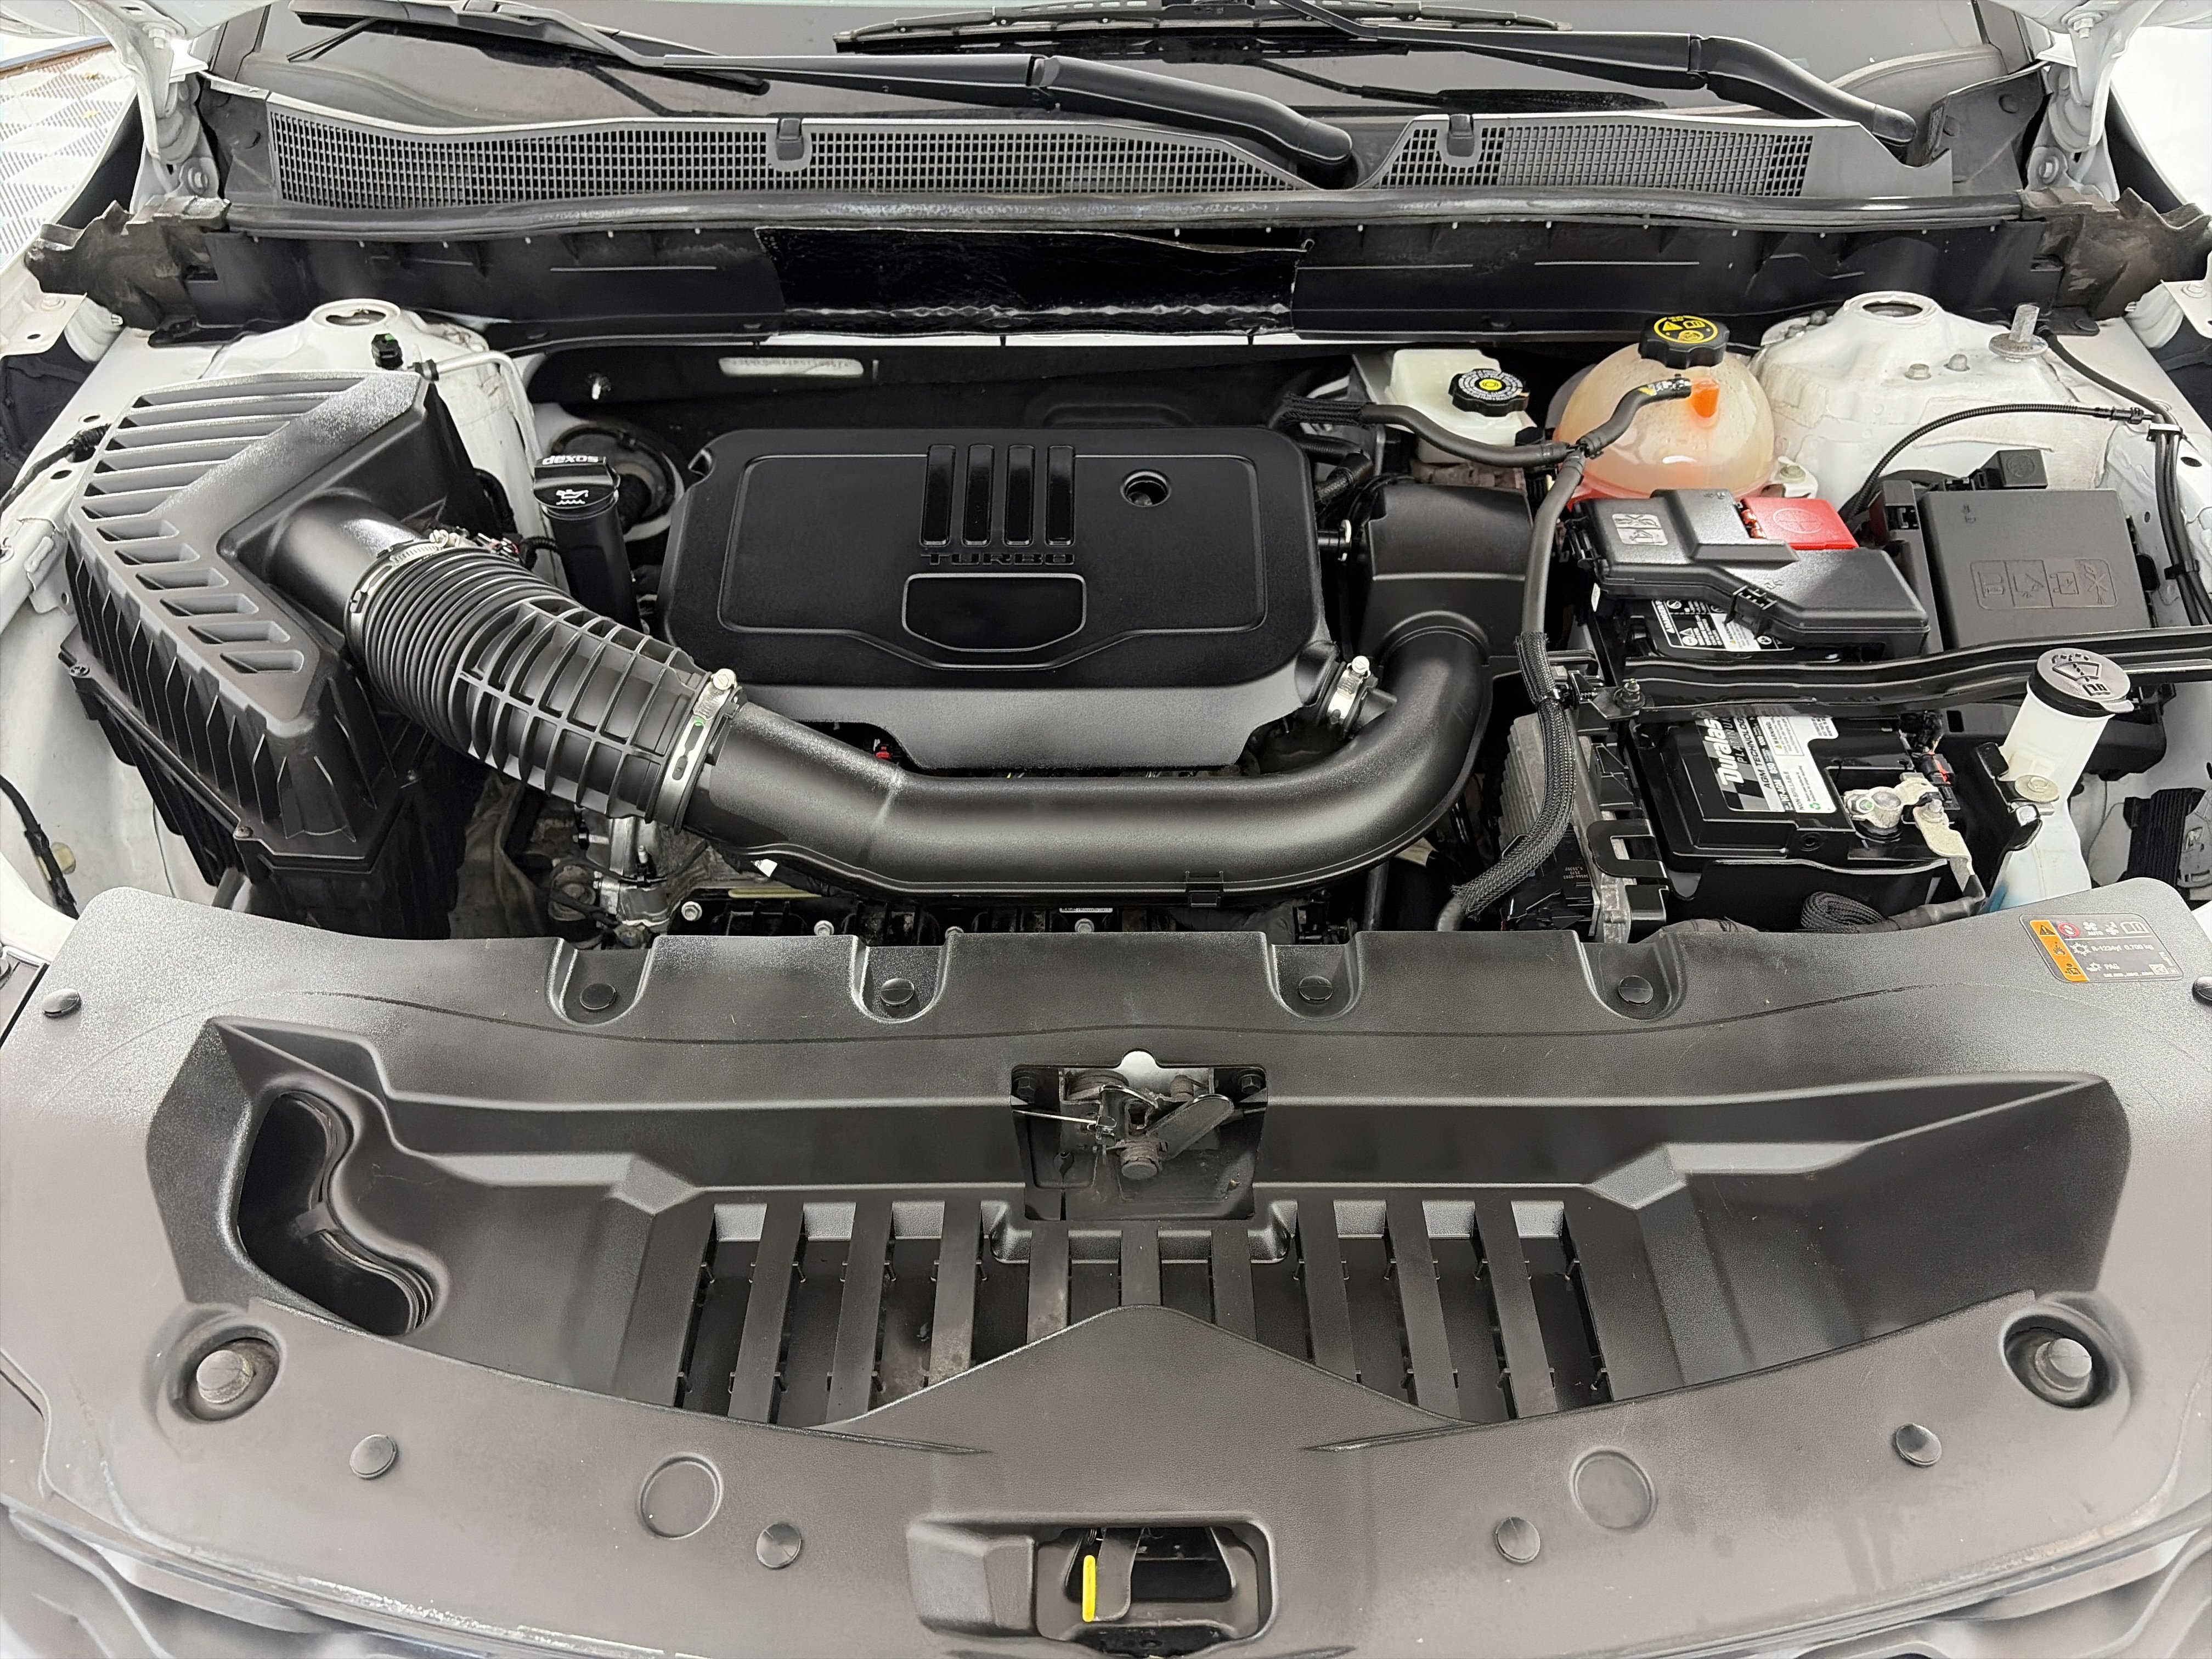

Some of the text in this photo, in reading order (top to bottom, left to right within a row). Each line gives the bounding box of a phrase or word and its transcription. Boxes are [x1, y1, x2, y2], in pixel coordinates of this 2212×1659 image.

[542, 455, 599, 465] dexos
[921, 553, 1074, 565] TURBO
[1737, 717, 1763, 766] TECHNOLOG
[1704, 719, 1744, 785] Duralas
[1767, 763, 1778, 774] 850
[1758, 769, 1772, 789] AGM
